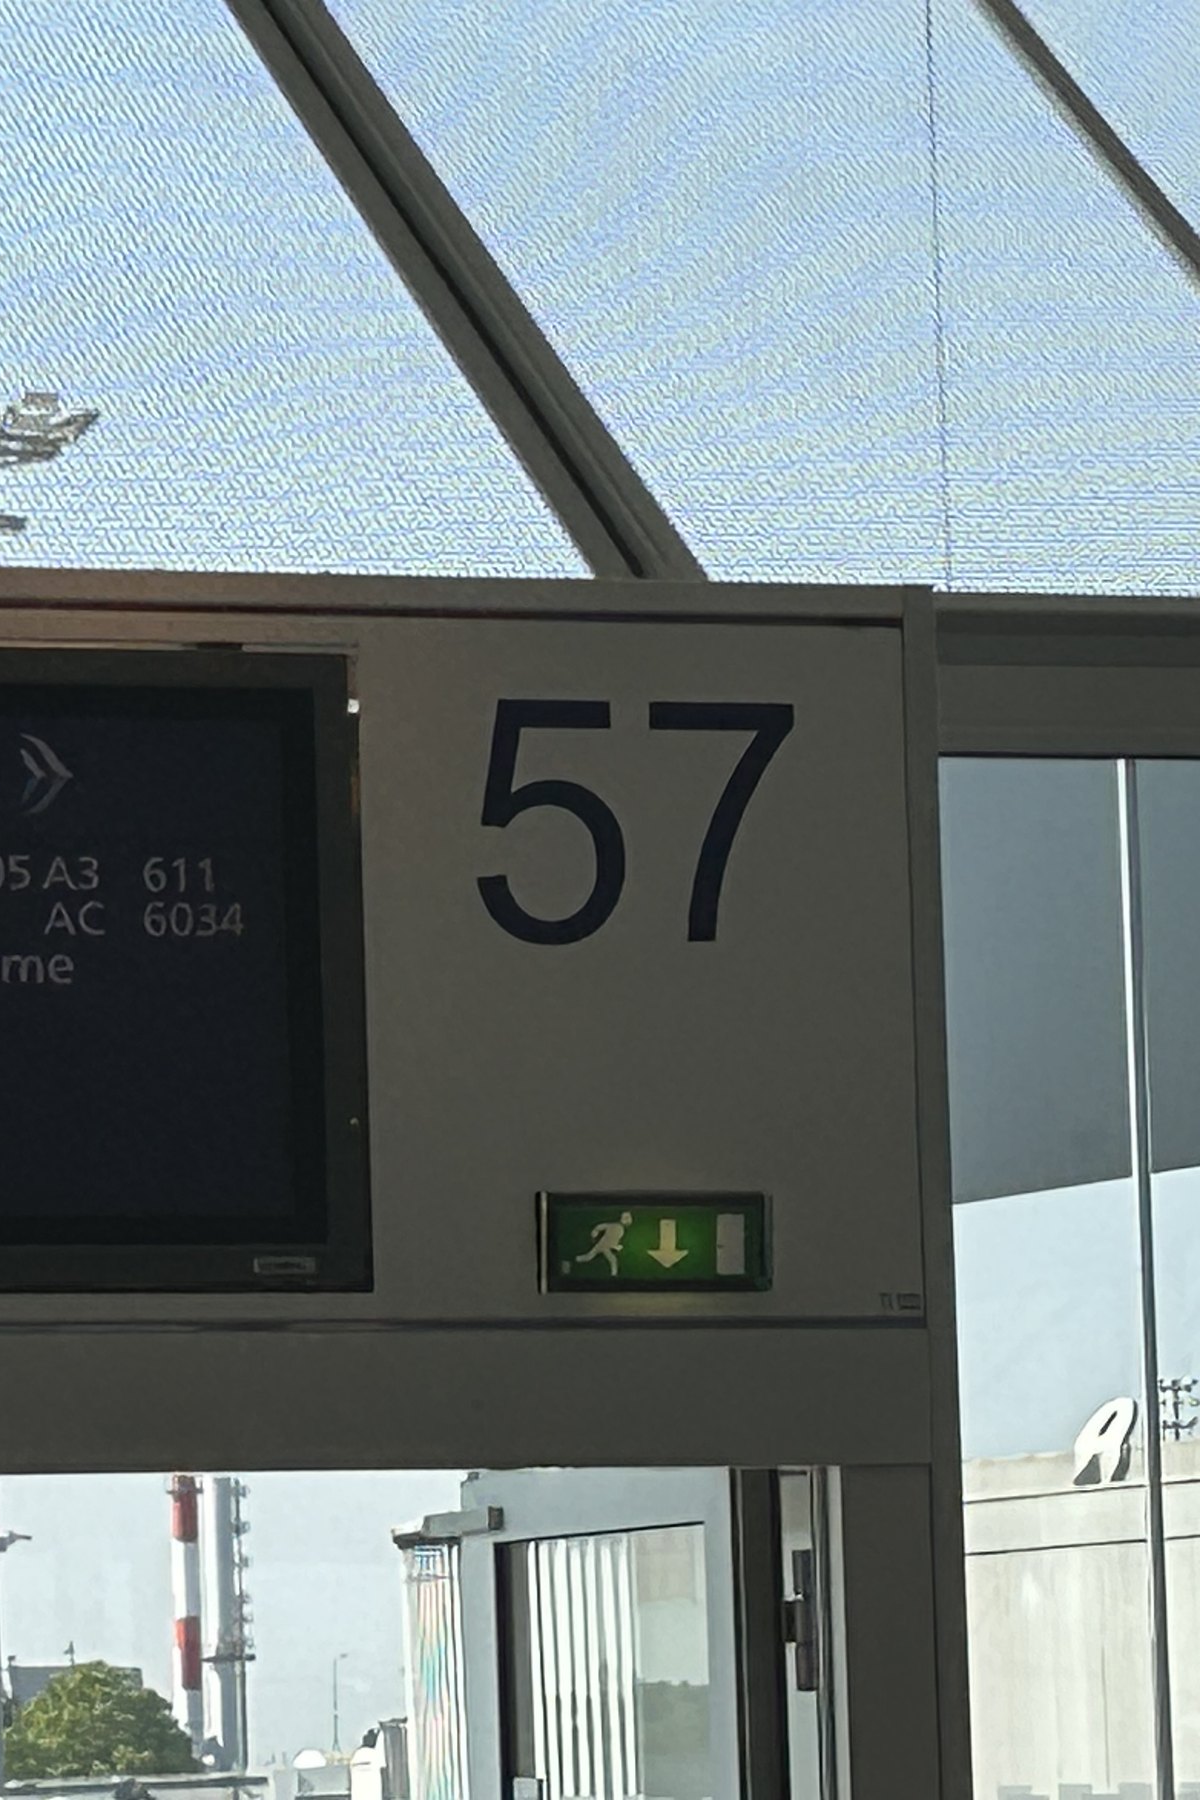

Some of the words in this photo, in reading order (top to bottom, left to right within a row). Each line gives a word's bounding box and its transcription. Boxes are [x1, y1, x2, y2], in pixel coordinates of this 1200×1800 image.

[476, 698, 795, 946] 57
[42, 855, 100, 892] A3
[142, 856, 216, 894] 611
[44, 900, 107, 937] AC
[143, 902, 246, 938] 6034
